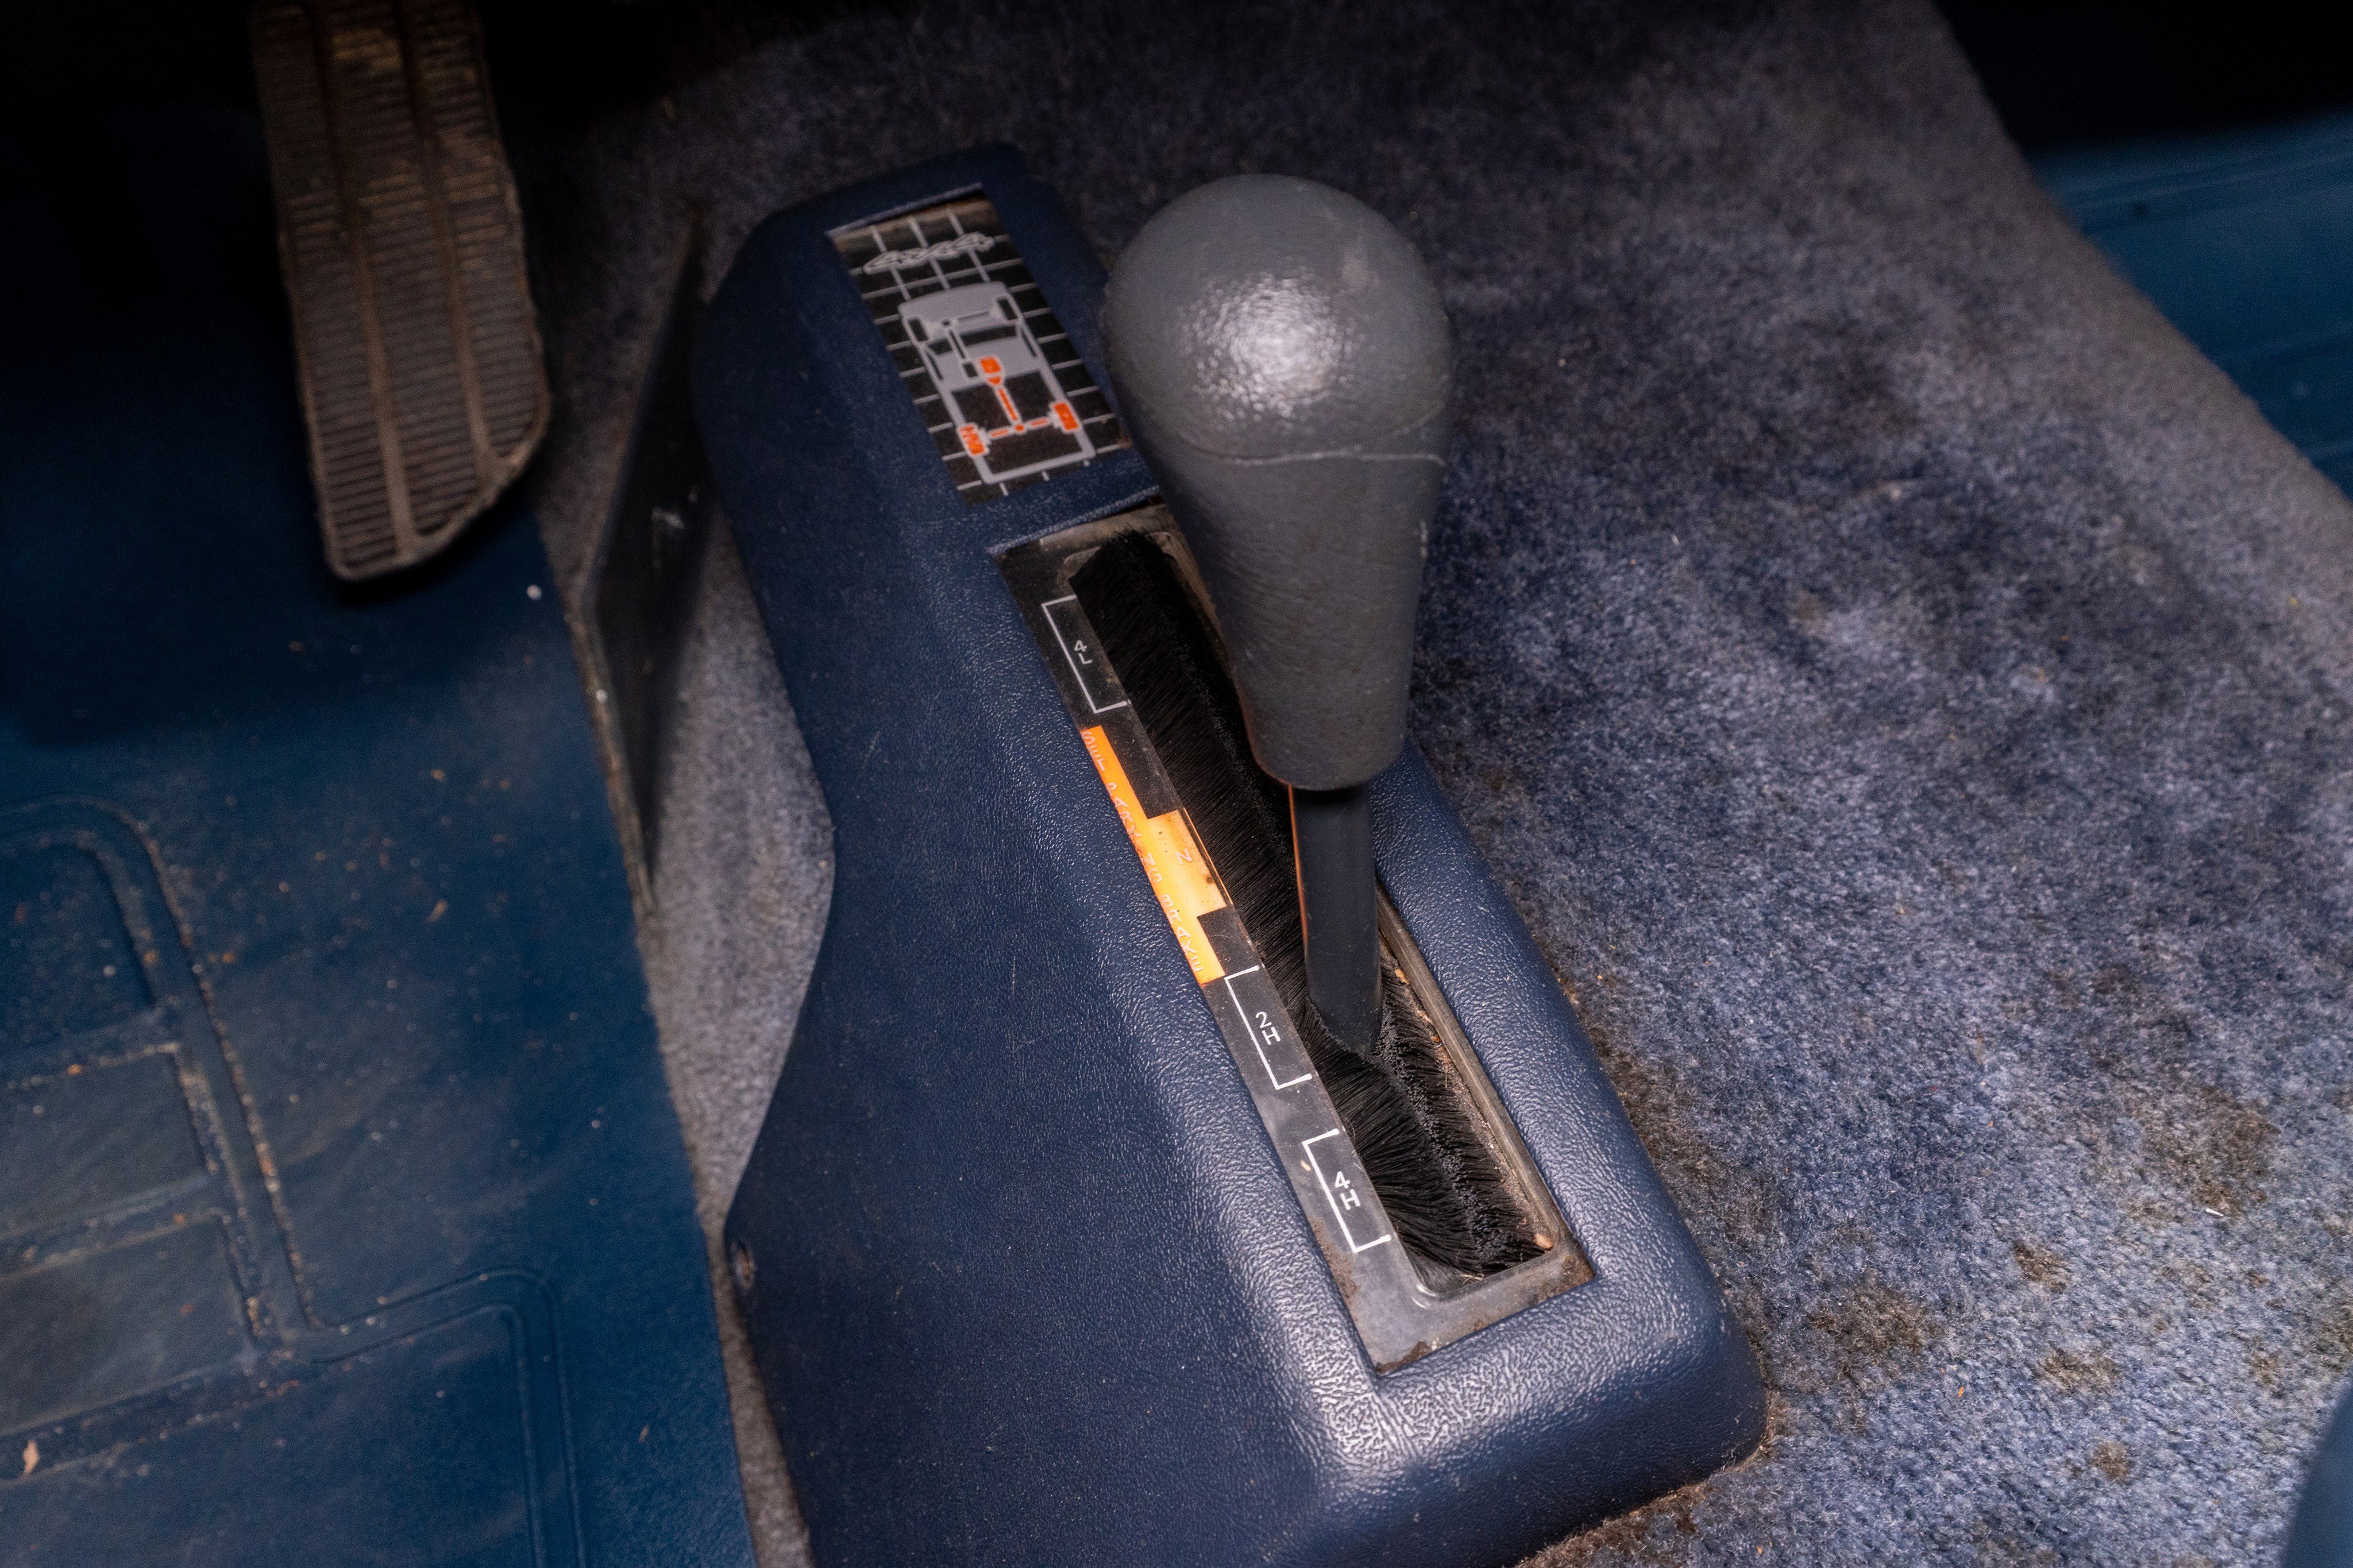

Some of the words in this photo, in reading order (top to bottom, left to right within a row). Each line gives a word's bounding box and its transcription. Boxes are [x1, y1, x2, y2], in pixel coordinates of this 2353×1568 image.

[1081, 731, 1106, 772] SET
[1106, 782, 1162, 883] PARKNG
[1160, 894, 1203, 972] BRAKE
[1256, 1011, 1281, 1045] 2H
[1334, 1172, 1361, 1210] 4H
